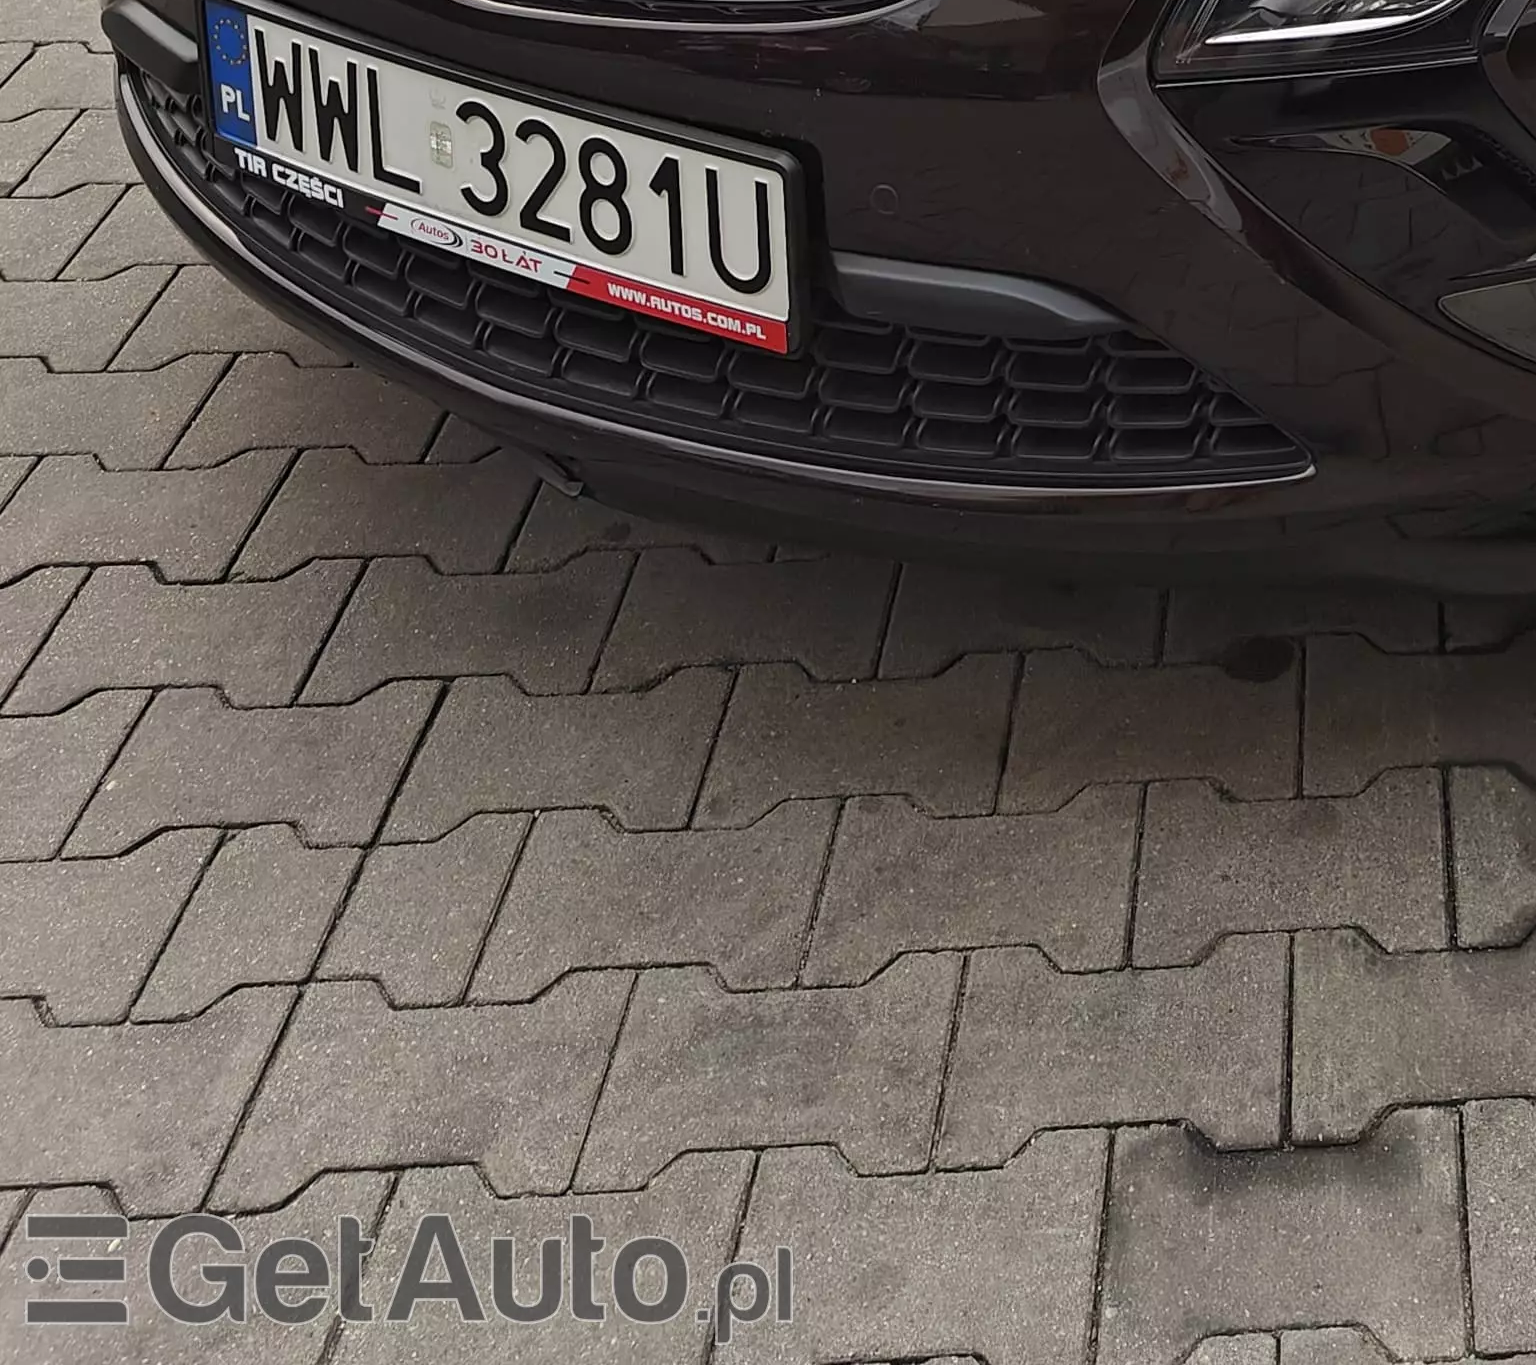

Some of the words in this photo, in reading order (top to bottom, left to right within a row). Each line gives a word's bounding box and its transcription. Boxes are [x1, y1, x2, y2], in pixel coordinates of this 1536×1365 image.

[220, 84, 250, 121] PL
[234, 147, 267, 178] TIR
[271, 163, 344, 209] CZĘŚCI
[254, 28, 422, 195] WWL
[455, 99, 770, 295] 3281U
[418, 221, 450, 241] Autos
[471, 239, 498, 259] 30
[607, 282, 767, 341] WWW.AUTOS.COM.PL
